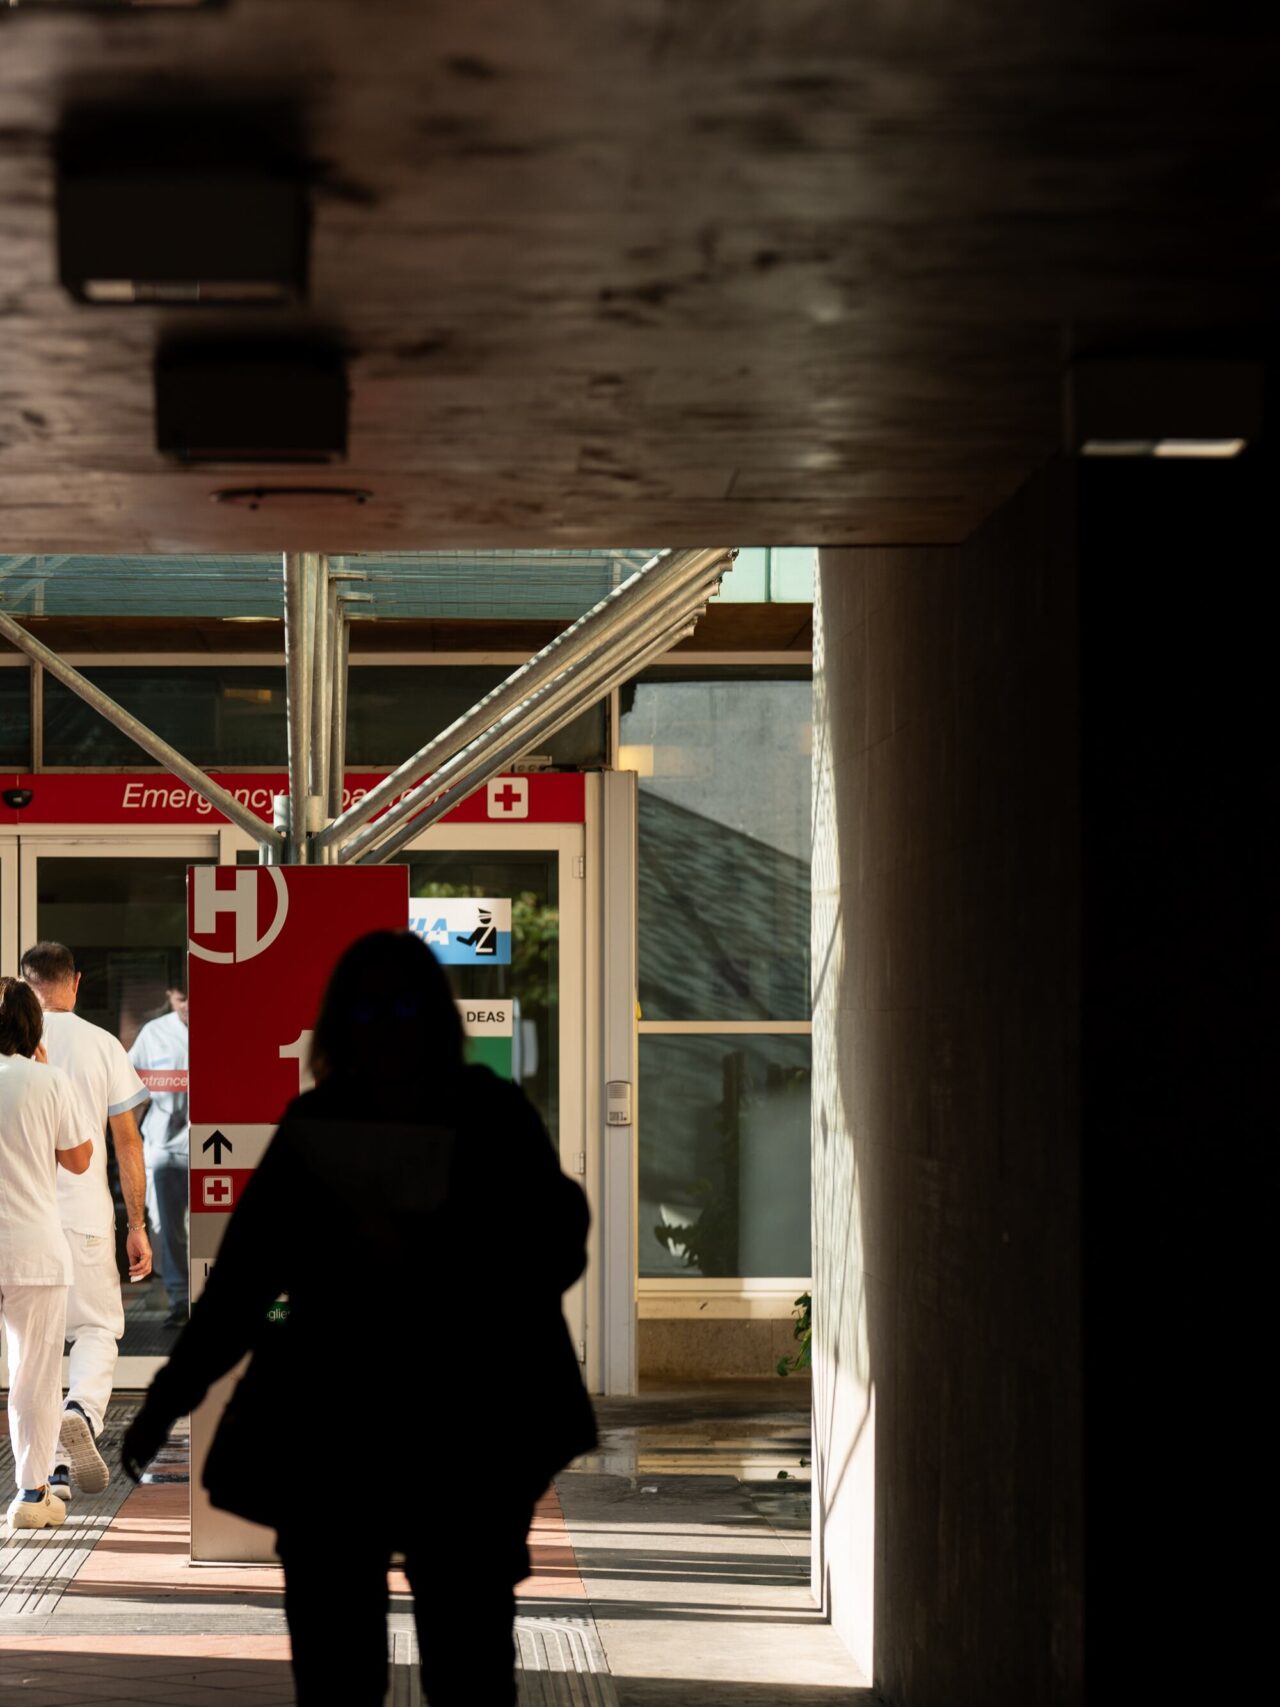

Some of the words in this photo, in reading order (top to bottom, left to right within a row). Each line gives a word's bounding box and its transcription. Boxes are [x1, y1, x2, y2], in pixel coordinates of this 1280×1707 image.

[122, 783, 285, 814] Emergncy
[466, 1011, 505, 1023] DEAS
[141, 1074, 188, 1087] ntrance
